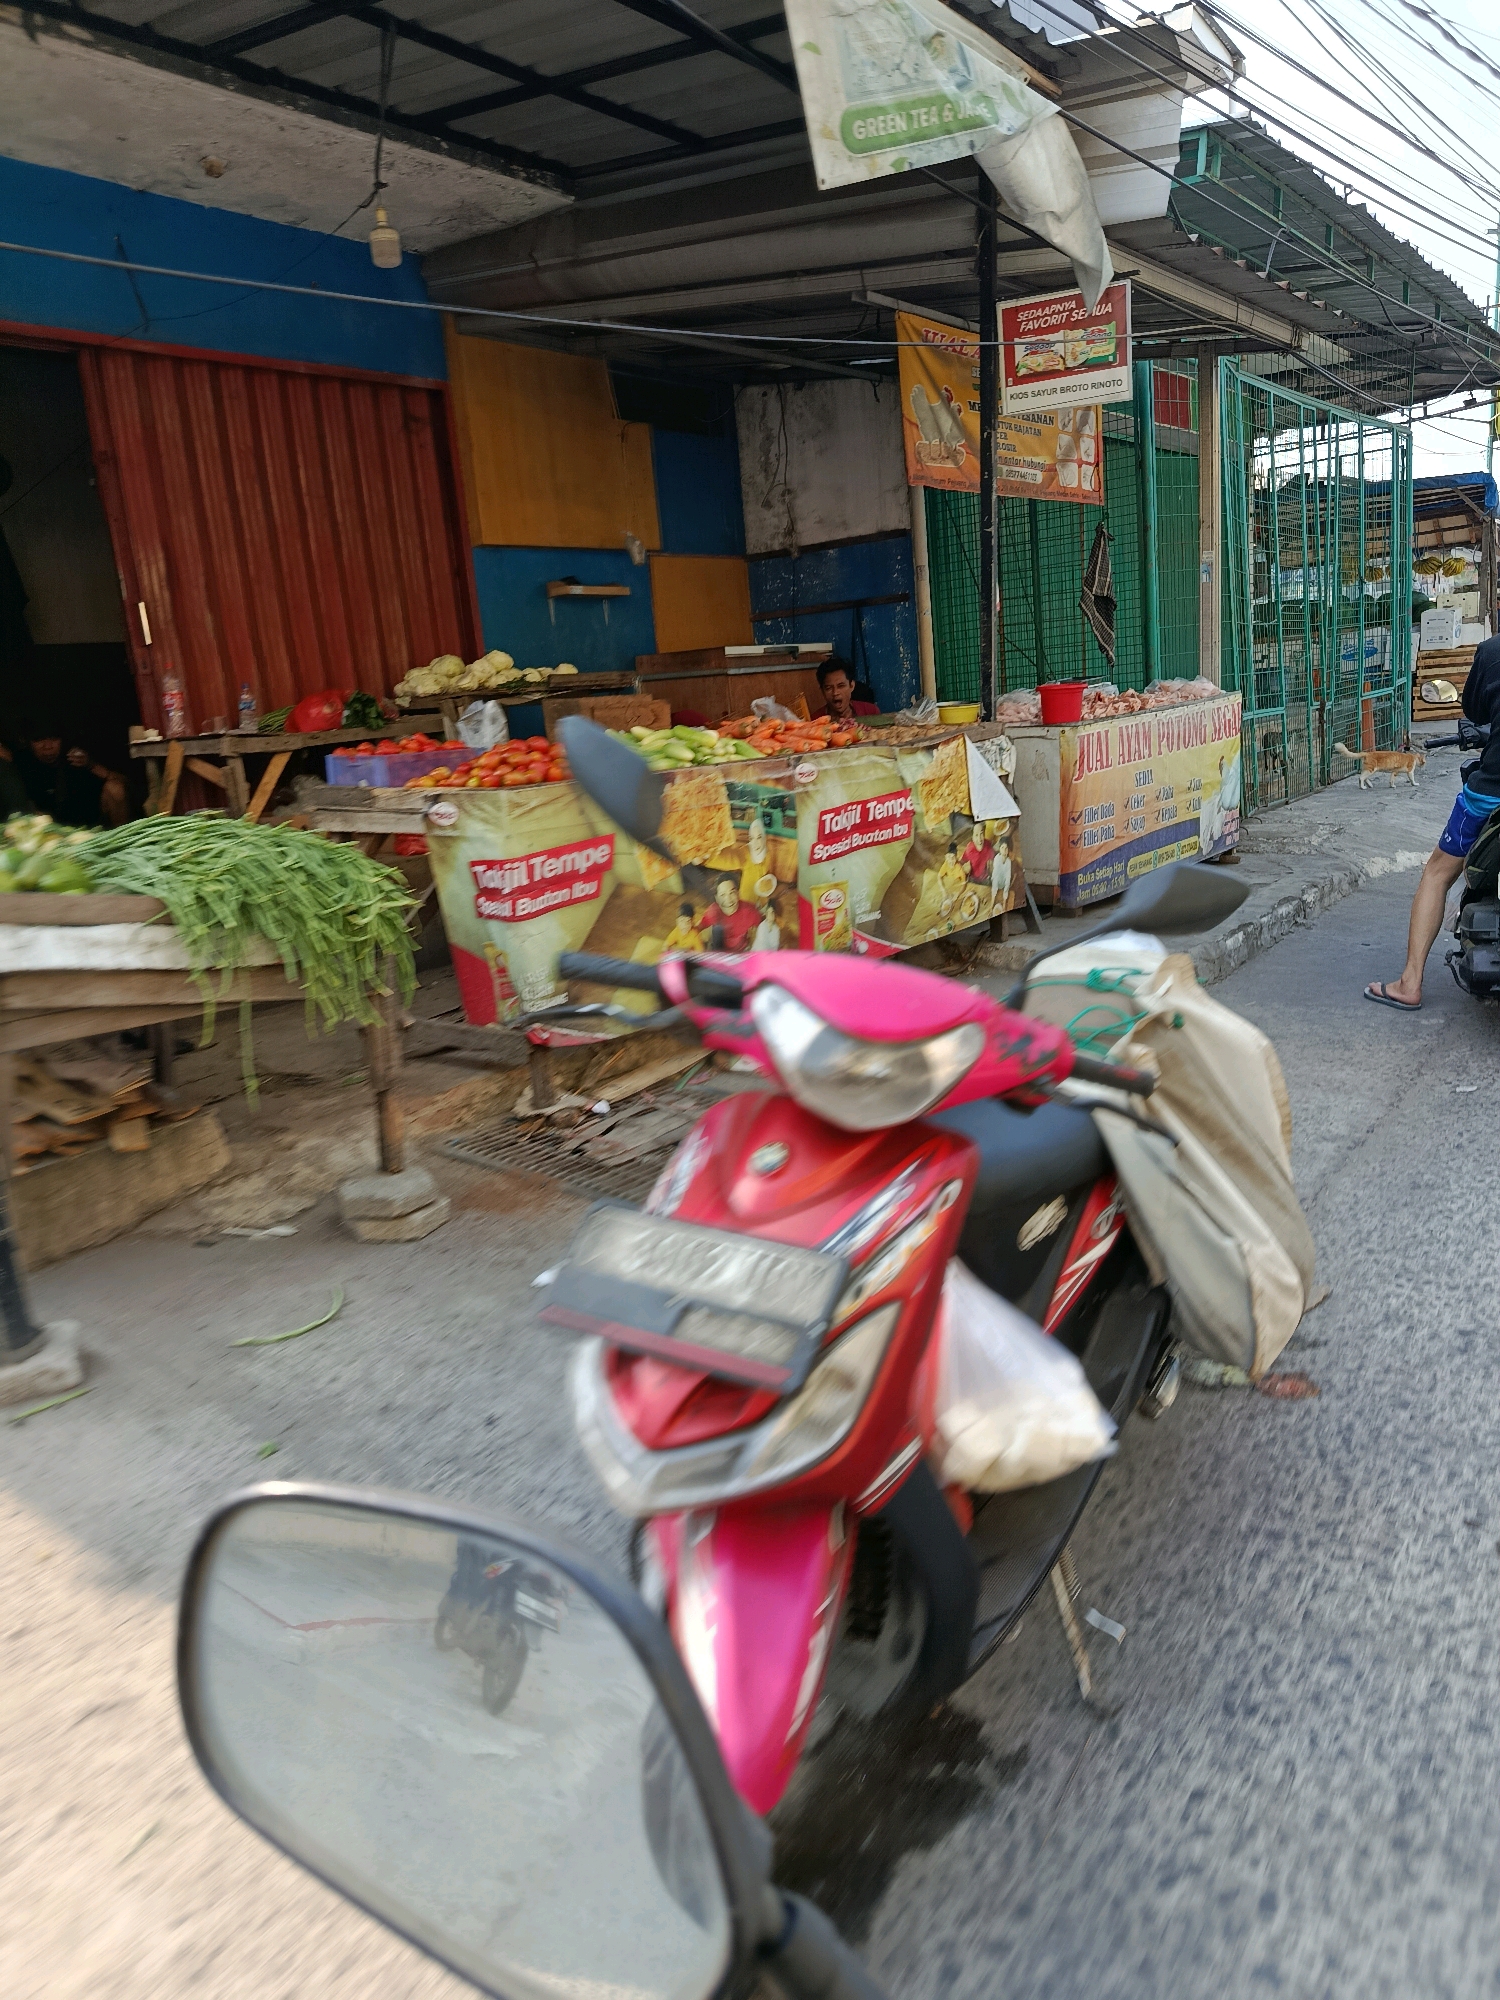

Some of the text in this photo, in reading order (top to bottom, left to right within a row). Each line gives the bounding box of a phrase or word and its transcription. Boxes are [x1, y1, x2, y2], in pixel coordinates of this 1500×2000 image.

[852, 111, 908, 140] GREEN
[910, 105, 940, 130] TEA
[942, 103, 954, 123] &
[1016, 300, 1077, 322] SEDAAPNYA
[1019, 312, 1070, 333] FAVORIT
[1009, 378, 1123, 401] KIOS SAYUR BROTO RINOTO
[1022, 457, 1047, 472] hubungi
[1072, 728, 1113, 783] JUAL
[1117, 720, 1153, 766] AYAM
[1157, 710, 1208, 756] POTONG
[1134, 768, 1154, 788] SEDIA
[1083, 801, 1115, 825] Fillet Dada
[1130, 793, 1146, 811] Ceker
[1161, 804, 1178, 822] Kepala
[821, 794, 915, 835] Takjil Tempe
[812, 822, 909, 861] Spesial Buatan Ibu
[1083, 824, 1115, 847] Fillet Paha
[472, 843, 611, 895] Takjil Tempe
[1077, 858, 1126, 887] Buka Setiap Hari
[515, 887, 571, 917] Buatan
[571, 879, 599, 900] Ibu
[1076, 887, 1092, 902] Jam
